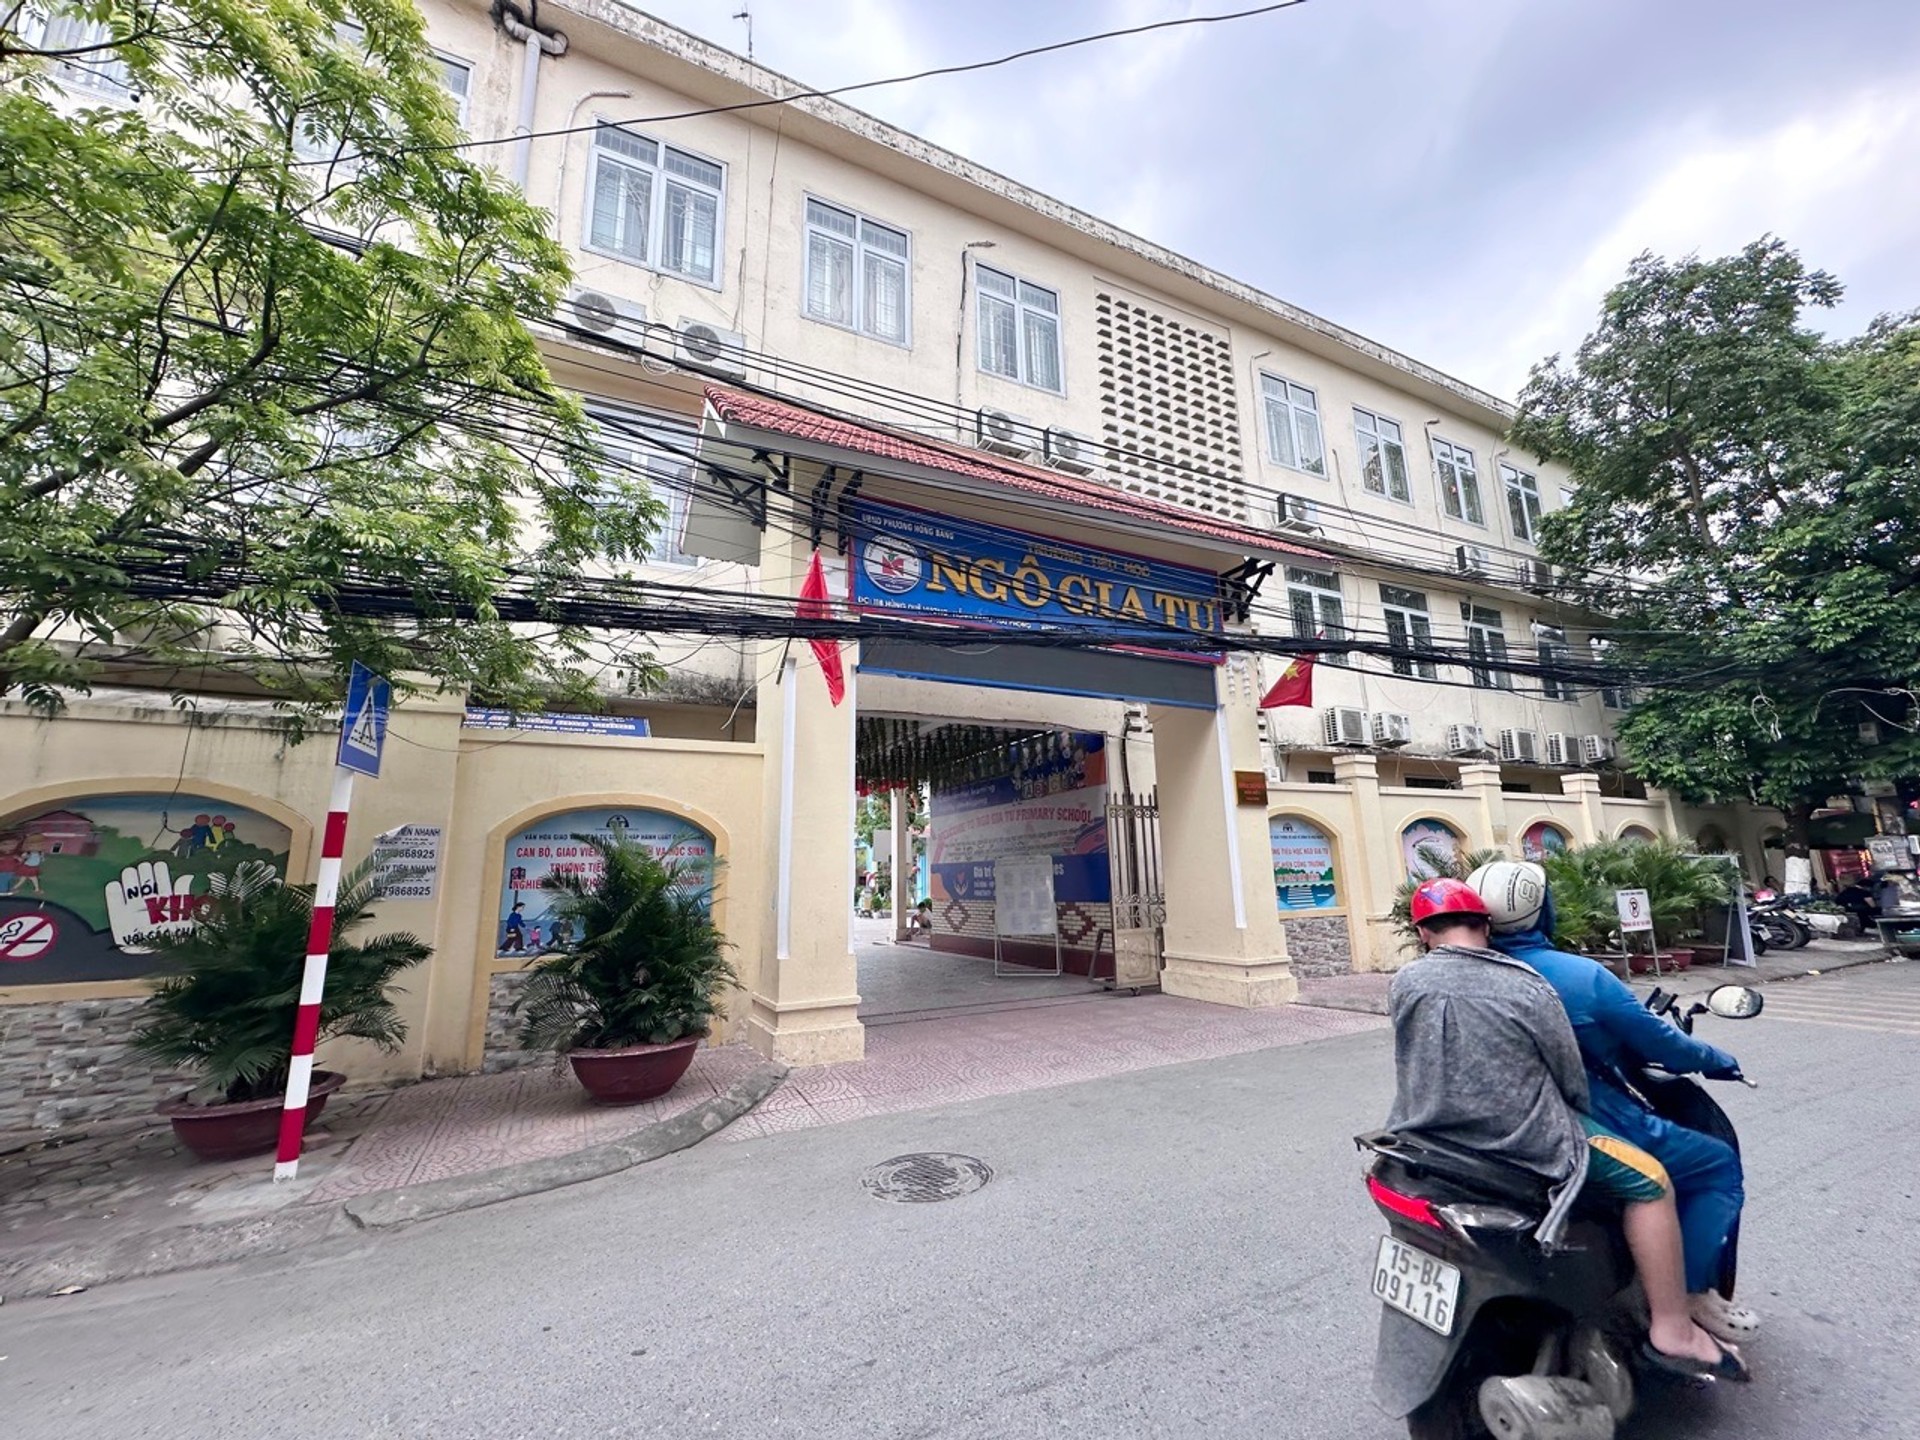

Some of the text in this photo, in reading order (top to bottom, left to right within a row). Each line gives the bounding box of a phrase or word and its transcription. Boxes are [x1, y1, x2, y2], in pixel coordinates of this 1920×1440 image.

[926, 553, 1052, 607] NGÔ
[1015, 807, 1055, 823] PRIMARY
[1056, 806, 1093, 824] SCHOOL
[556, 846, 577, 857] GIAO
[127, 879, 159, 899] NÓI
[1391, 1245, 1444, 1293] 15-B4
[1376, 1268, 1449, 1327] 091.16
